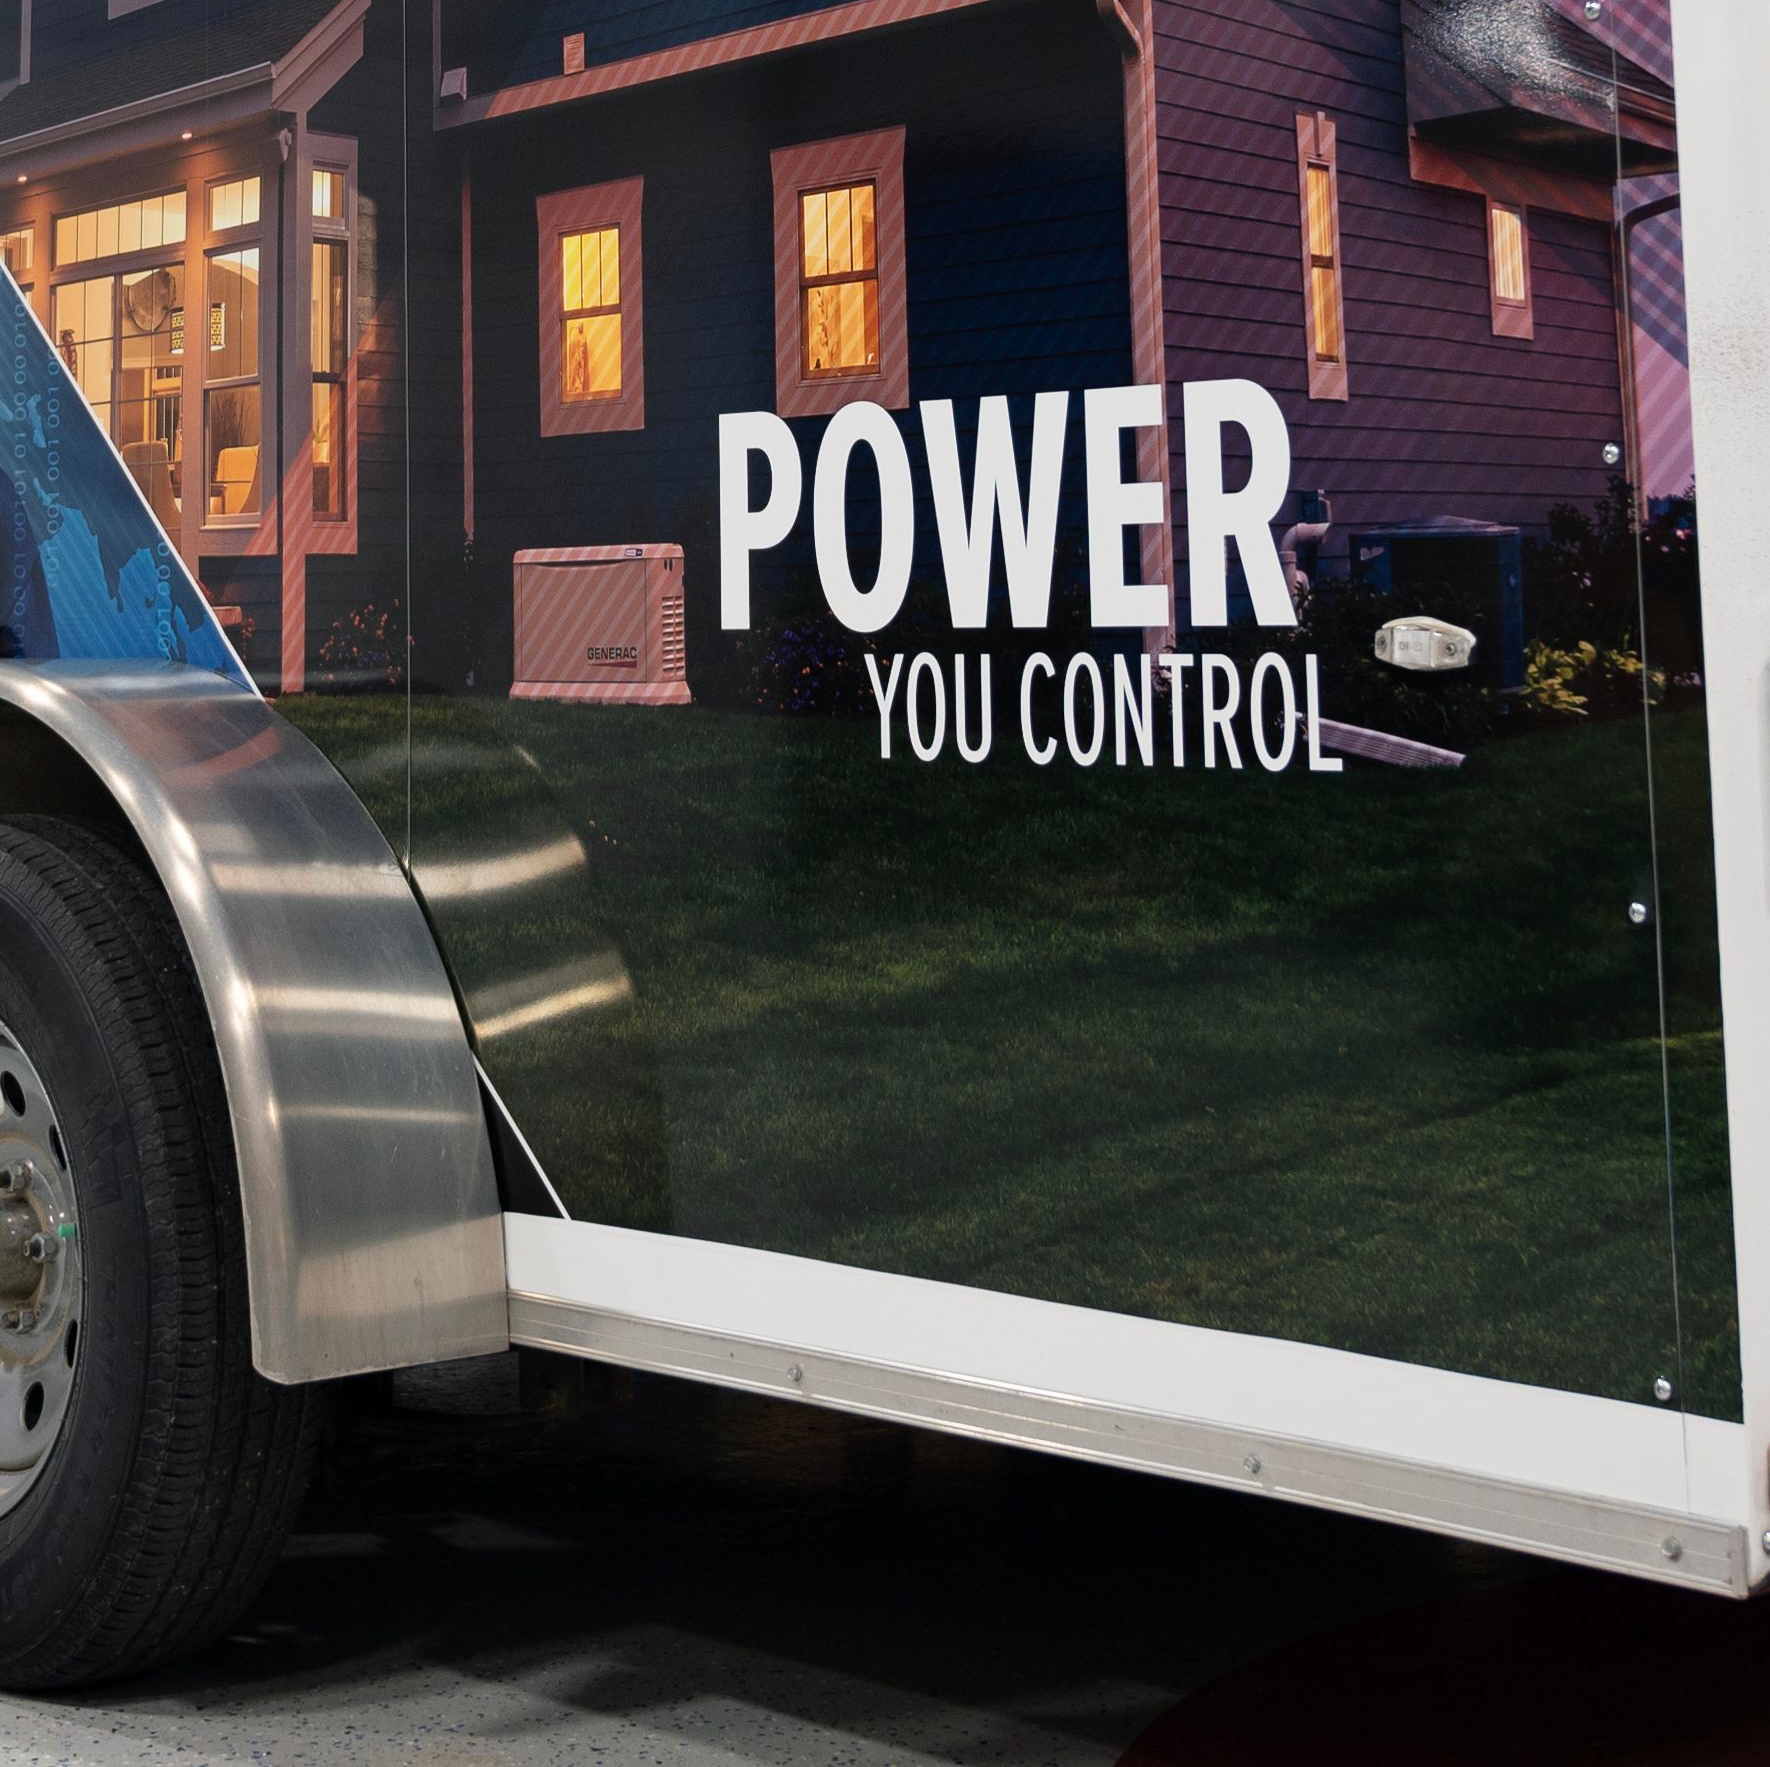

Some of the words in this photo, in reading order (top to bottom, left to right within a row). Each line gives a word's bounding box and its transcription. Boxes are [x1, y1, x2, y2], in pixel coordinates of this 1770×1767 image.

[717, 378, 1299, 633] POWER
[587, 646, 638, 661] GENERAC
[864, 651, 993, 764] YOU
[1019, 651, 1345, 773] CONTROL
